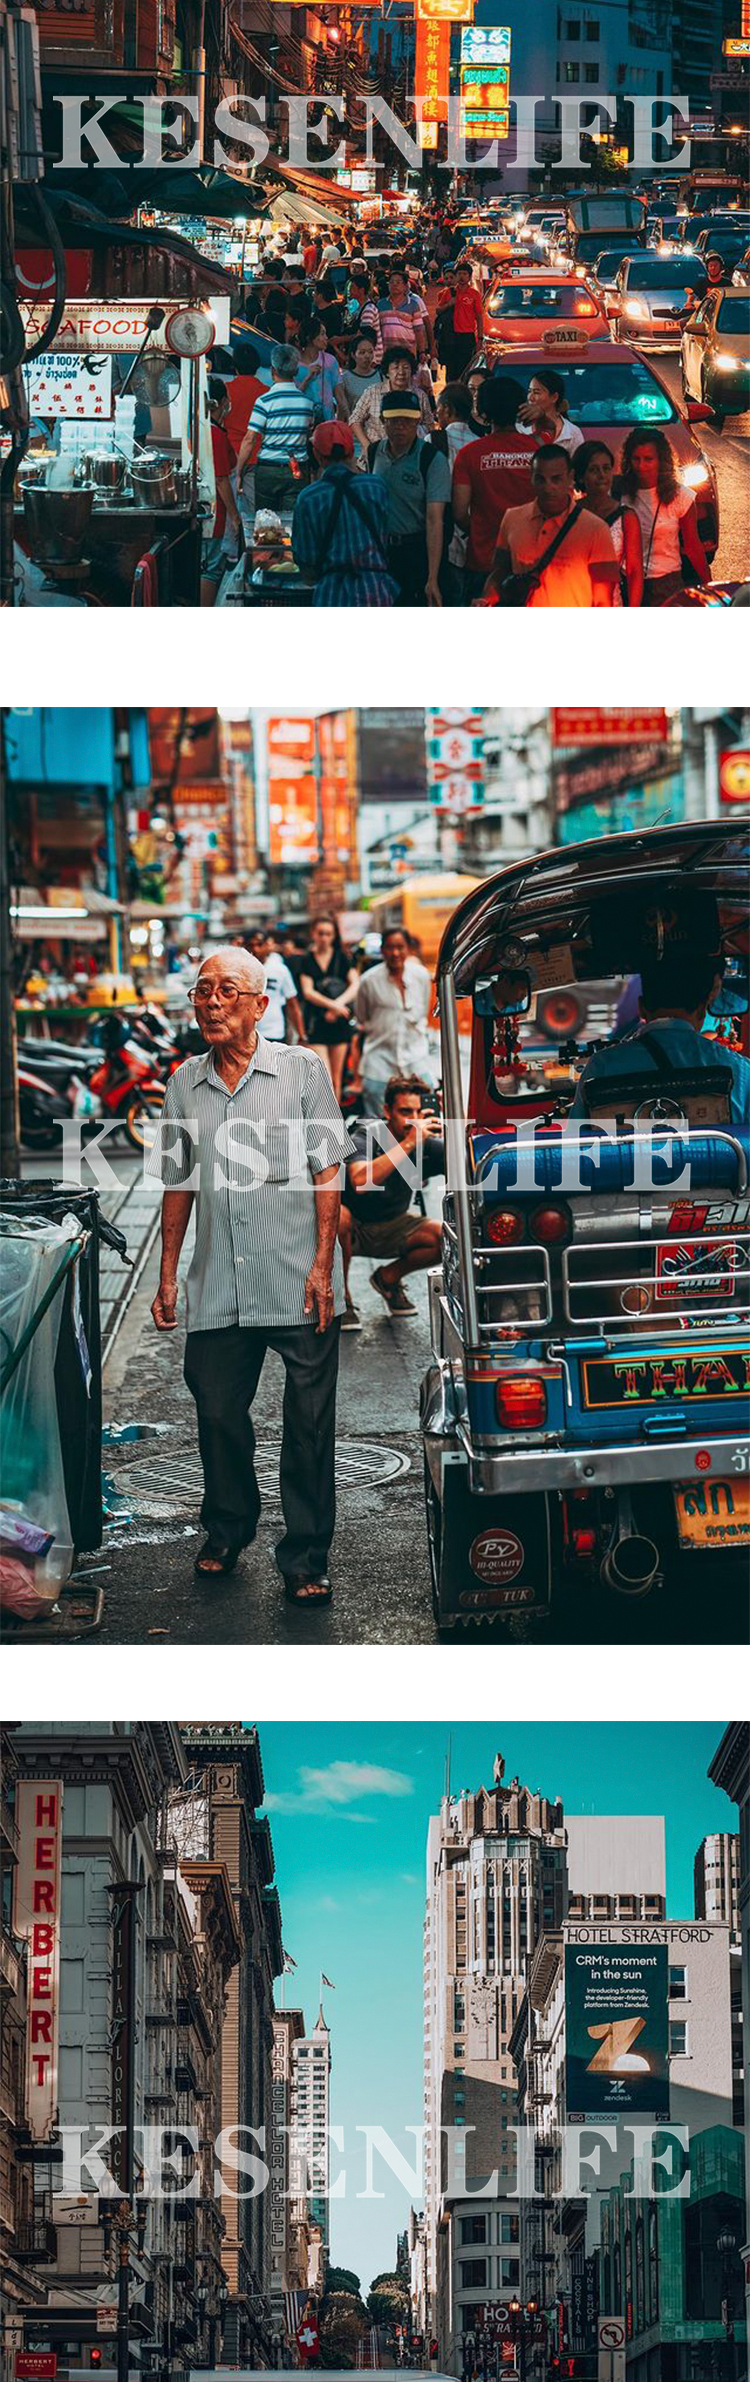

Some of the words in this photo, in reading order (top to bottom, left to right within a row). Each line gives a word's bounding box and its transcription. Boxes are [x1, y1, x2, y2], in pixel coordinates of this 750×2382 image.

[555, 331, 578, 342] TAXI
[56, 356, 81, 368] 100%
[31, 1794, 58, 2087] HERBERT
[567, 1929, 617, 1943] HOTEL
[621, 1928, 713, 1944] STRATFORD
[575, 1955, 609, 1966] CRM's
[611, 1956, 657, 1966] moment
[591, 1969, 601, 1979] in
[603, 1969, 621, 1979] the
[623, 1972, 642, 1980] sun
[587, 1987, 619, 1996] Introducing
[596, 1995, 649, 2003] developer-friendly
[584, 2002, 609, 2010] platform
[604, 2093, 632, 2102] zendesk
[570, 2113, 584, 2122] BIG
[586, 2114, 618, 2122] OUTDOOR
[271, 2177, 285, 2248] HOTEL
[586, 2295, 595, 2322] SHOP
[483, 2307, 542, 2322] HOEL
